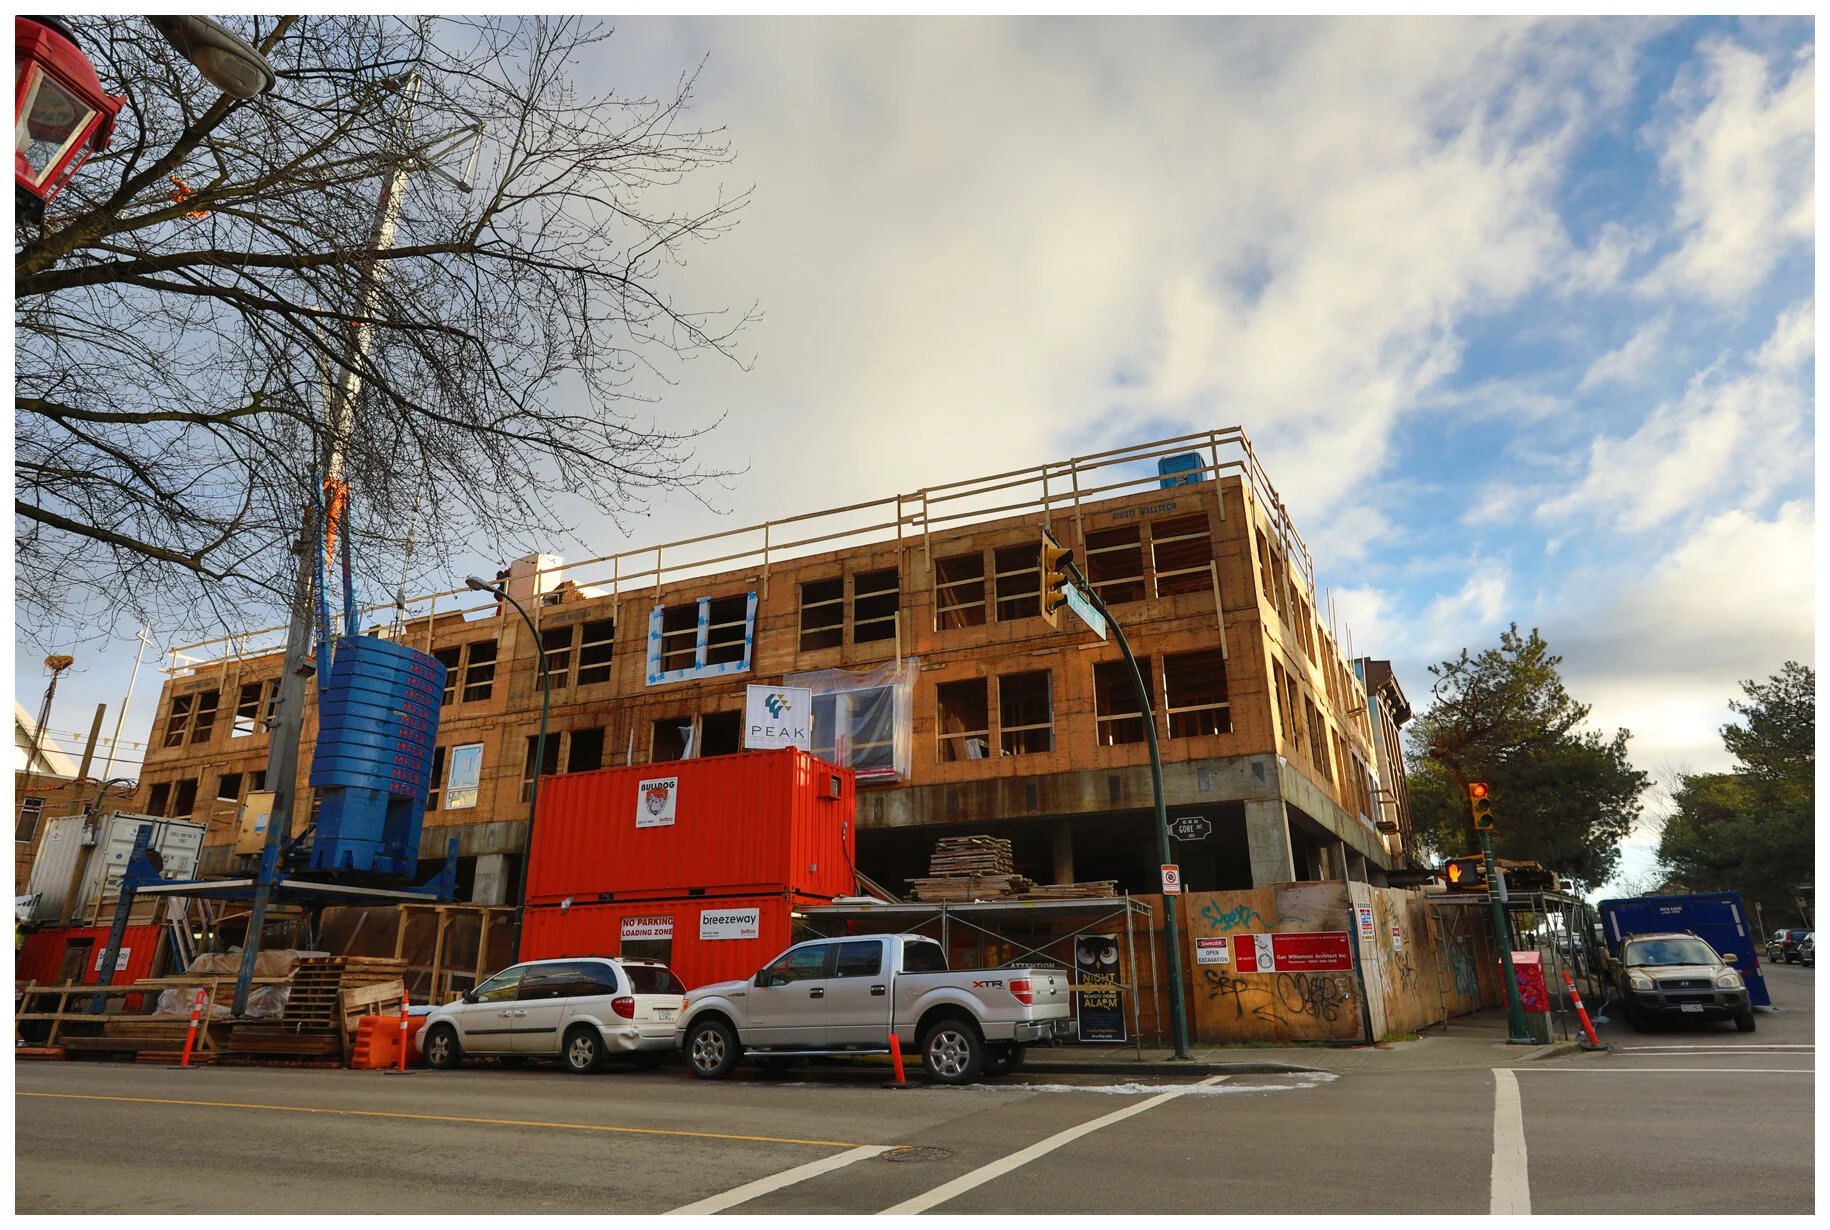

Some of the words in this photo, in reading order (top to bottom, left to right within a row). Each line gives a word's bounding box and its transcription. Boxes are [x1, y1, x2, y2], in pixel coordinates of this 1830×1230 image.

[1140, 503, 1177, 515] WALLTECH
[412, 651, 438, 668] MEGA
[410, 664, 436, 680] MEGA
[408, 677, 433, 694] MEGA
[405, 689, 431, 706] MEGA
[403, 702, 429, 718] MEGA
[401, 715, 427, 731] MEGA
[399, 728, 425, 745] MEGA
[751, 725, 805, 738] PEAK
[397, 742, 424, 757] MEGA
[394, 755, 421, 770] MEGA
[392, 768, 419, 783] MEGA
[390, 782, 418, 797] MEGA
[641, 781, 675, 791] BULLDOG
[1179, 825, 1194, 833] GORE
[637, 917, 674, 926] PARKING
[702, 915, 756, 925] breezeway
[1083, 973, 1115, 982] NIGHT
